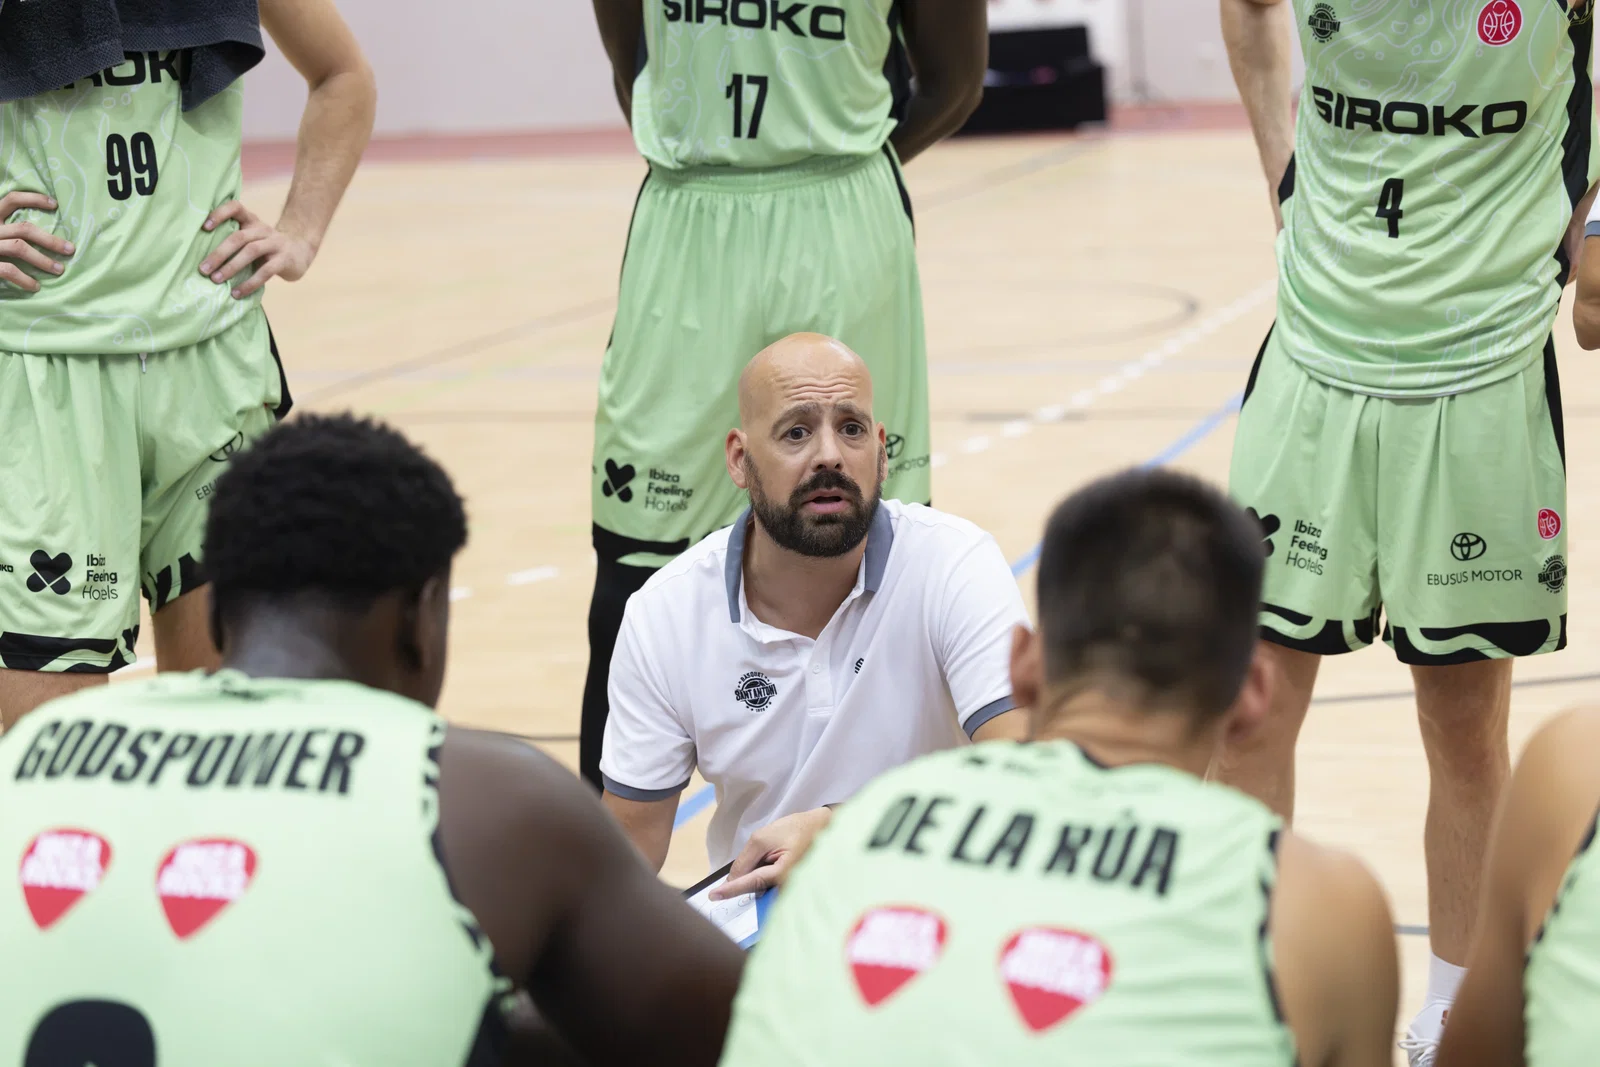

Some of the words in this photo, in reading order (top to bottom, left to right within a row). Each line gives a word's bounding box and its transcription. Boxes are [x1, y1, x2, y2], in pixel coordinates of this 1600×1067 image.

[663, 0, 846, 41] SIROKO
[726, 73, 768, 140] 17
[1312, 86, 1527, 138] SIROKO
[106, 132, 158, 200] 99
[1375, 178, 1404, 238] 4
[649, 468, 680, 483] Ibiza
[1294, 520, 1322, 538] Ibiza
[1427, 571, 1468, 585] EBUSUS
[1471, 569, 1523, 581] MOTOR
[15, 718, 366, 796] GODSPOWER
[866, 794, 956, 854] DE
[949, 801, 1039, 872] LA
